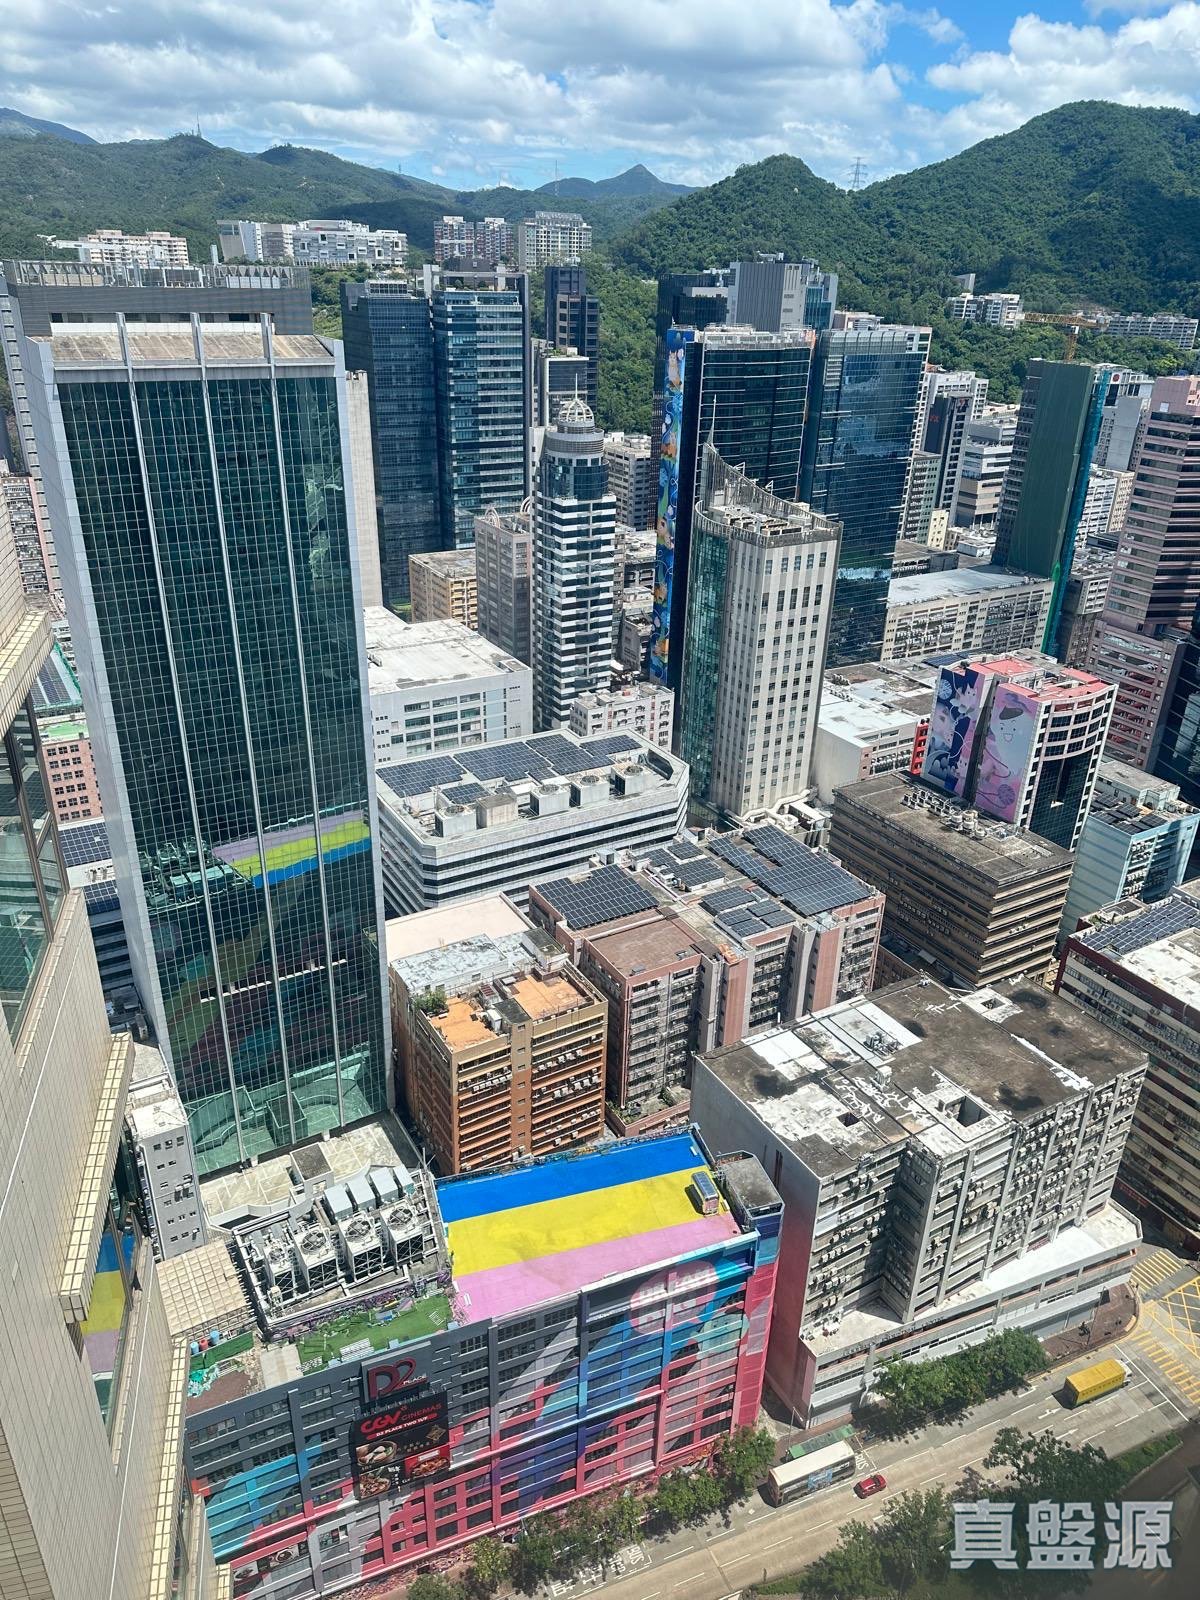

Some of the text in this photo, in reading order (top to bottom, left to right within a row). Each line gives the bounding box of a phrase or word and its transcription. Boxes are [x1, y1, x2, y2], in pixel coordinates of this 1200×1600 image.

[368, 1357, 422, 1398] D2
[403, 1373, 428, 1386] PLACE
[361, 1403, 442, 1434] CGV CINEMAS
[385, 1424, 403, 1434] PLACE
[403, 1419, 417, 1428] TWO
[626, 1545, 645, 1565] BUS
